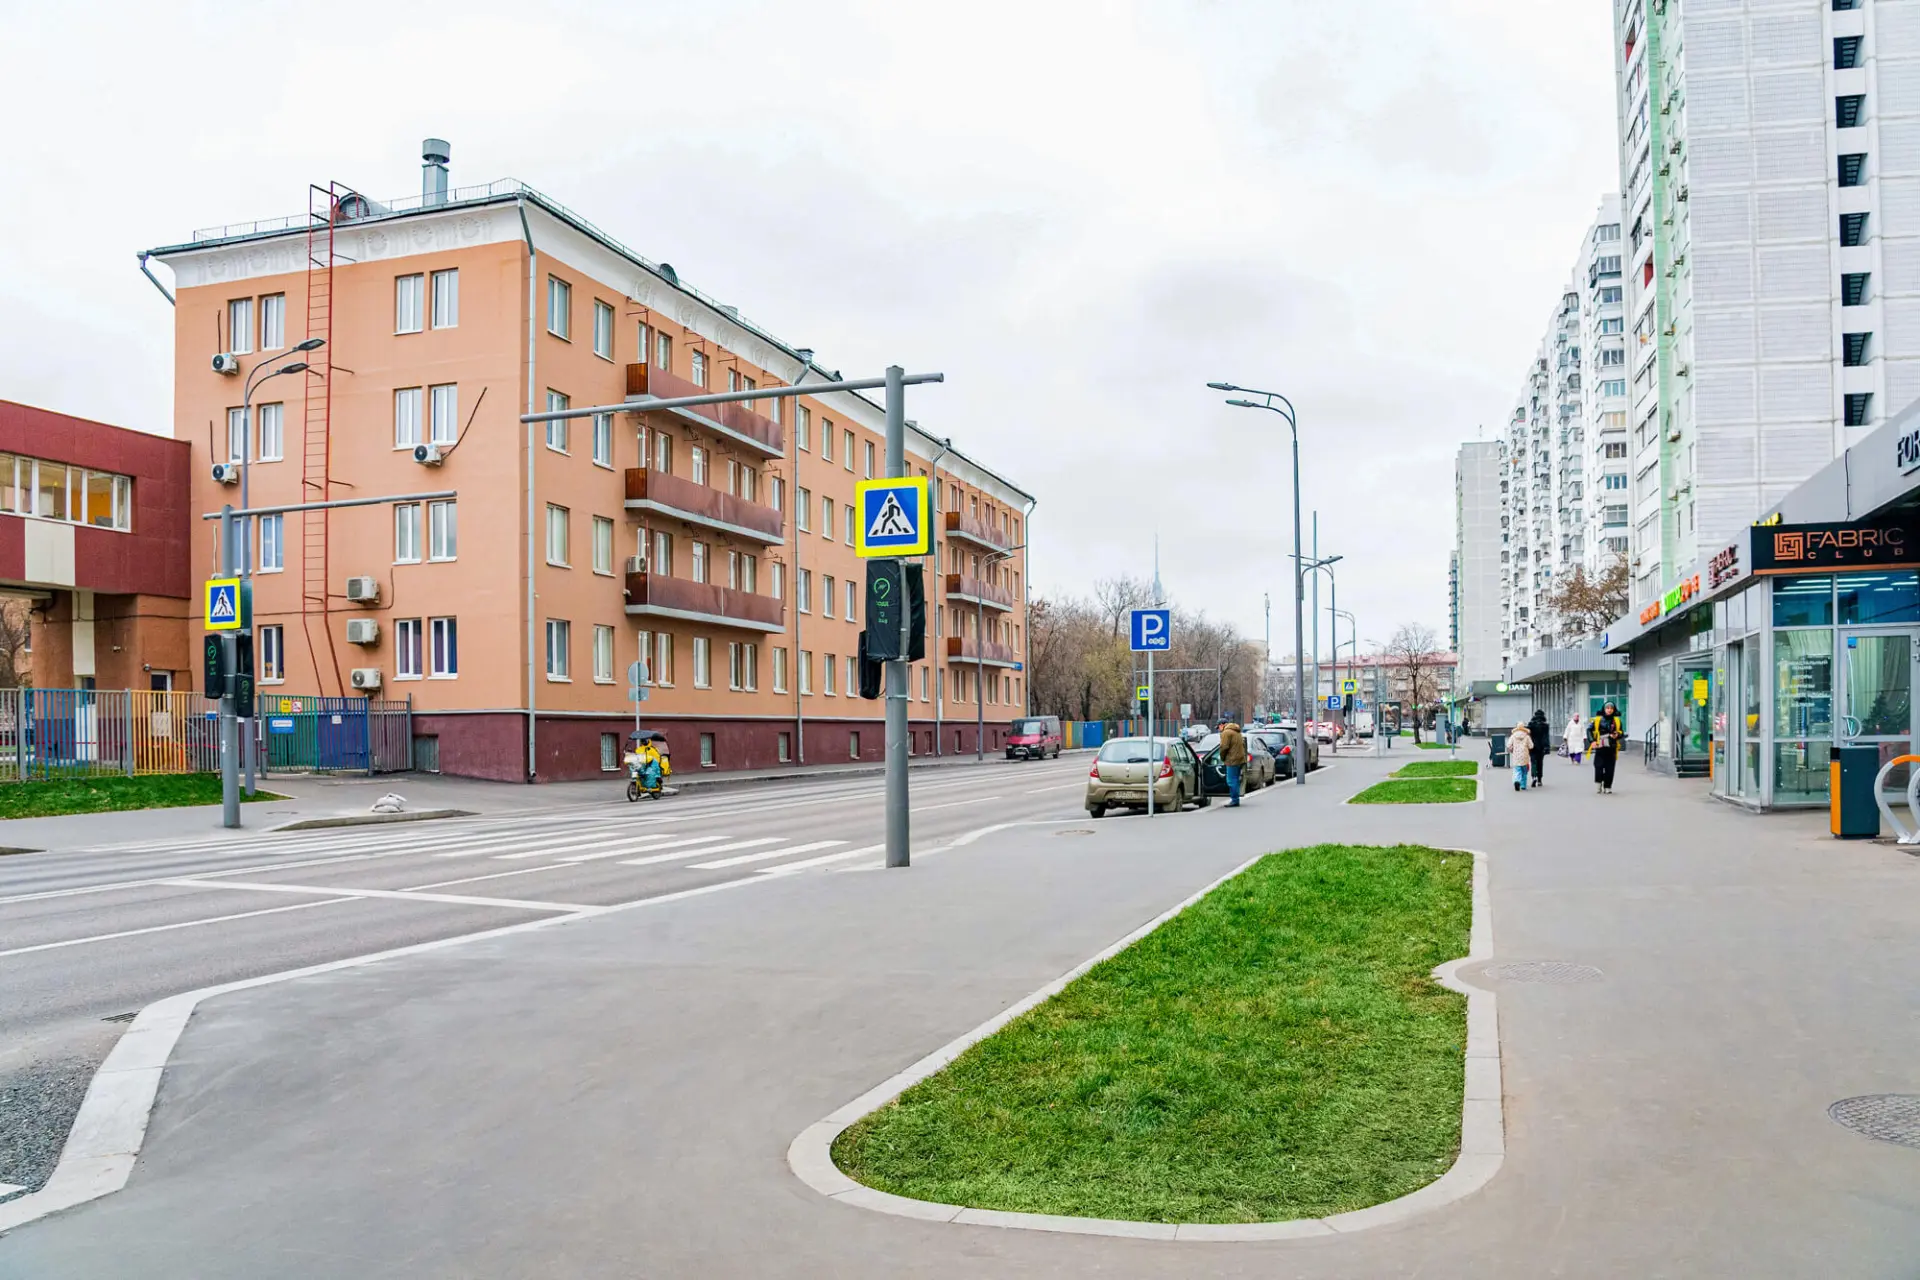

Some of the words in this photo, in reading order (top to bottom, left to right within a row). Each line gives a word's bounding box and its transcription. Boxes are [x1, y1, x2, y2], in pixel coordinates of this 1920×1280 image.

[1807, 527, 1904, 548] FABRIC
[1808, 547, 1903, 559] CLUB
[1142, 614, 1163, 645] P
